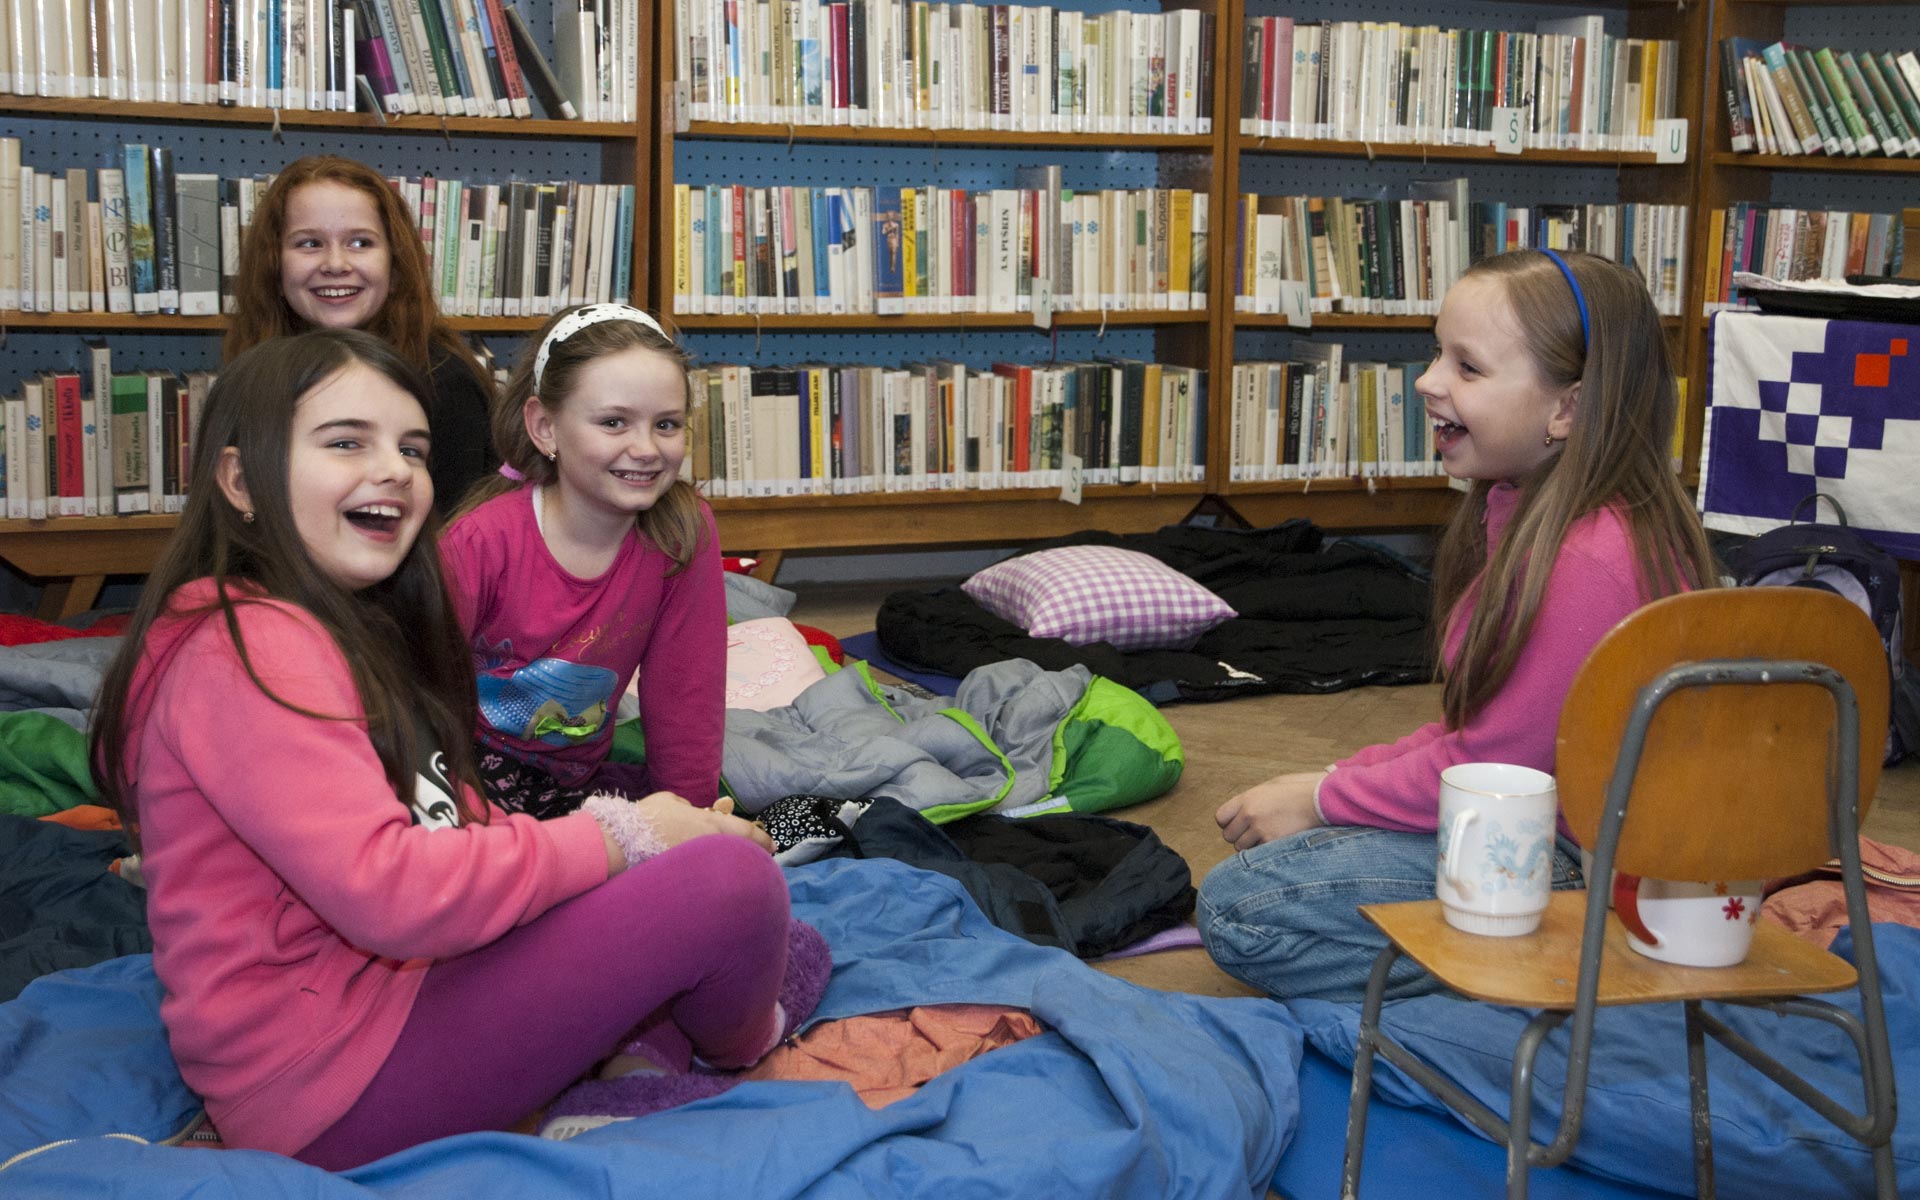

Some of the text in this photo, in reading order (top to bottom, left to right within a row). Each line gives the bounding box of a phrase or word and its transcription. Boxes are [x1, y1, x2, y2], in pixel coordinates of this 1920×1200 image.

[1001, 71, 1009, 111] PETERS
[1508, 112, 1518, 144] Š
[1671, 129, 1681, 154] U
[999, 208, 1009, 252] PUŠKIN
[1156, 191, 1167, 242] Rasputin
[1071, 466, 1077, 493] S
